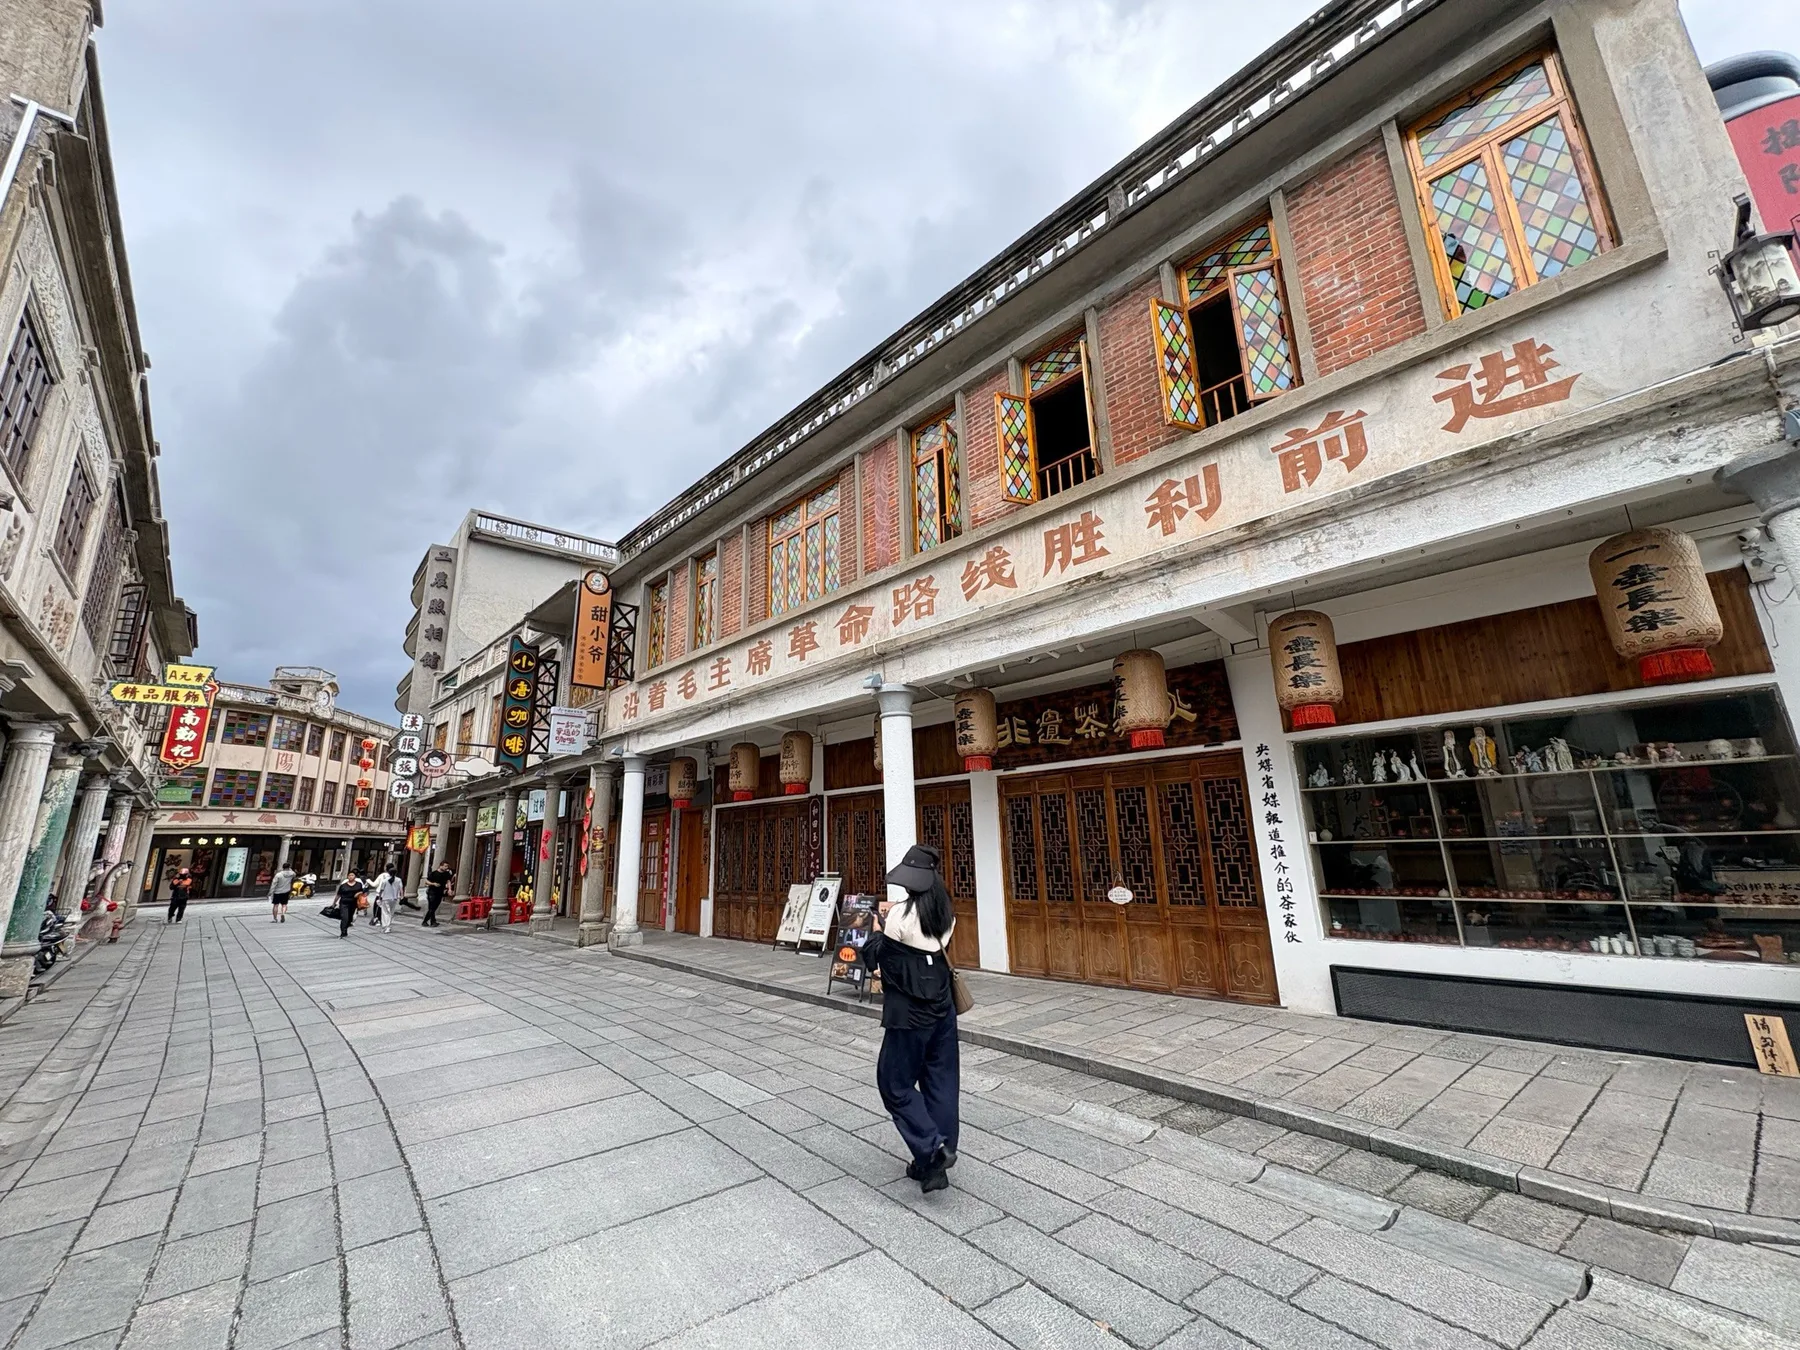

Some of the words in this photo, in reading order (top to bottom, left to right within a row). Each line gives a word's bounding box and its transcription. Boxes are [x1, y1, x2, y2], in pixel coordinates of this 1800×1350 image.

[622, 337, 1583, 720] 沿着毛主席革命路线胜利前进
[588, 605, 608, 664] 甜小爷
[168, 670, 205, 682] A元素
[505, 654, 535, 754] 小唐咖啡
[997, 688, 1197, 748] 非遺茶
[275, 751, 295, 773] 陽
[394, 715, 420, 795] 漢服旅拍
[1255, 743, 1303, 944] 央媒省媒報道推介的茶家伙
